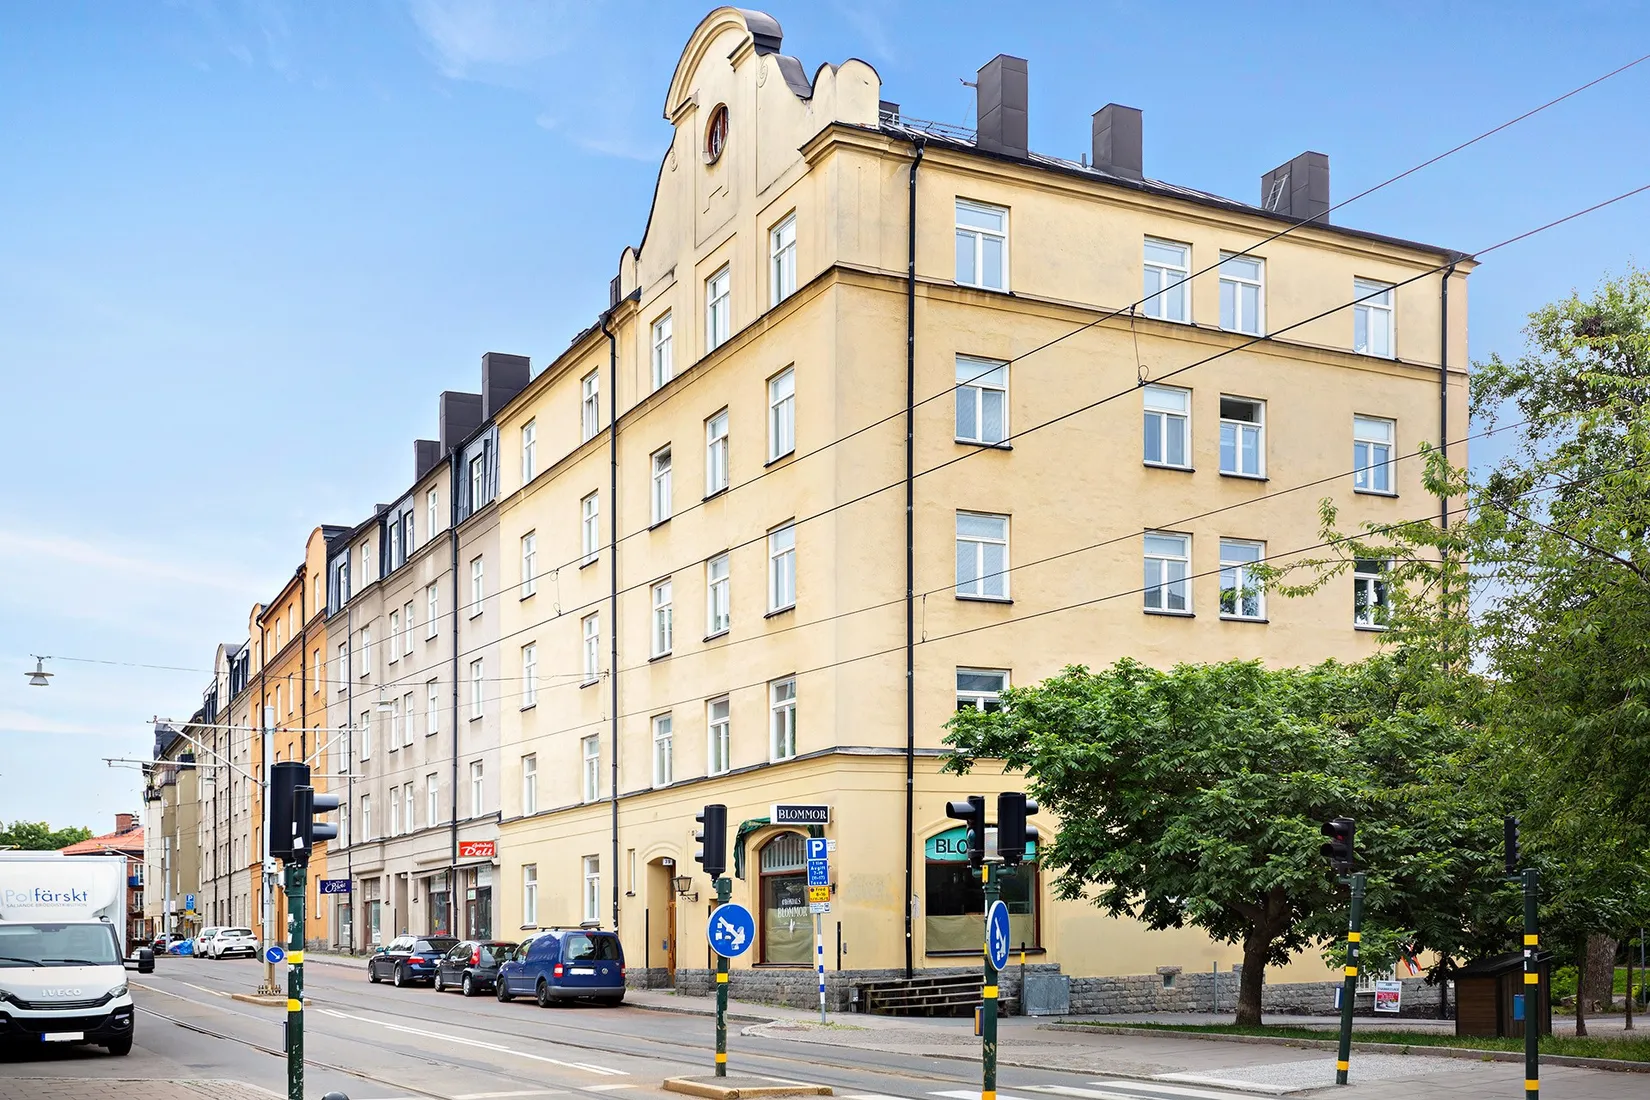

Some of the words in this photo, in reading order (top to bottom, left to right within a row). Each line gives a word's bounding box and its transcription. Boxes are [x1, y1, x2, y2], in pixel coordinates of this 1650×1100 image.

[778, 809, 827, 820] BLOMMOR
[812, 840, 824, 857] P
[5, 888, 88, 902] Polfärskt
[778, 906, 808, 918] BLOMMOR
[42, 988, 82, 997] IVECO
